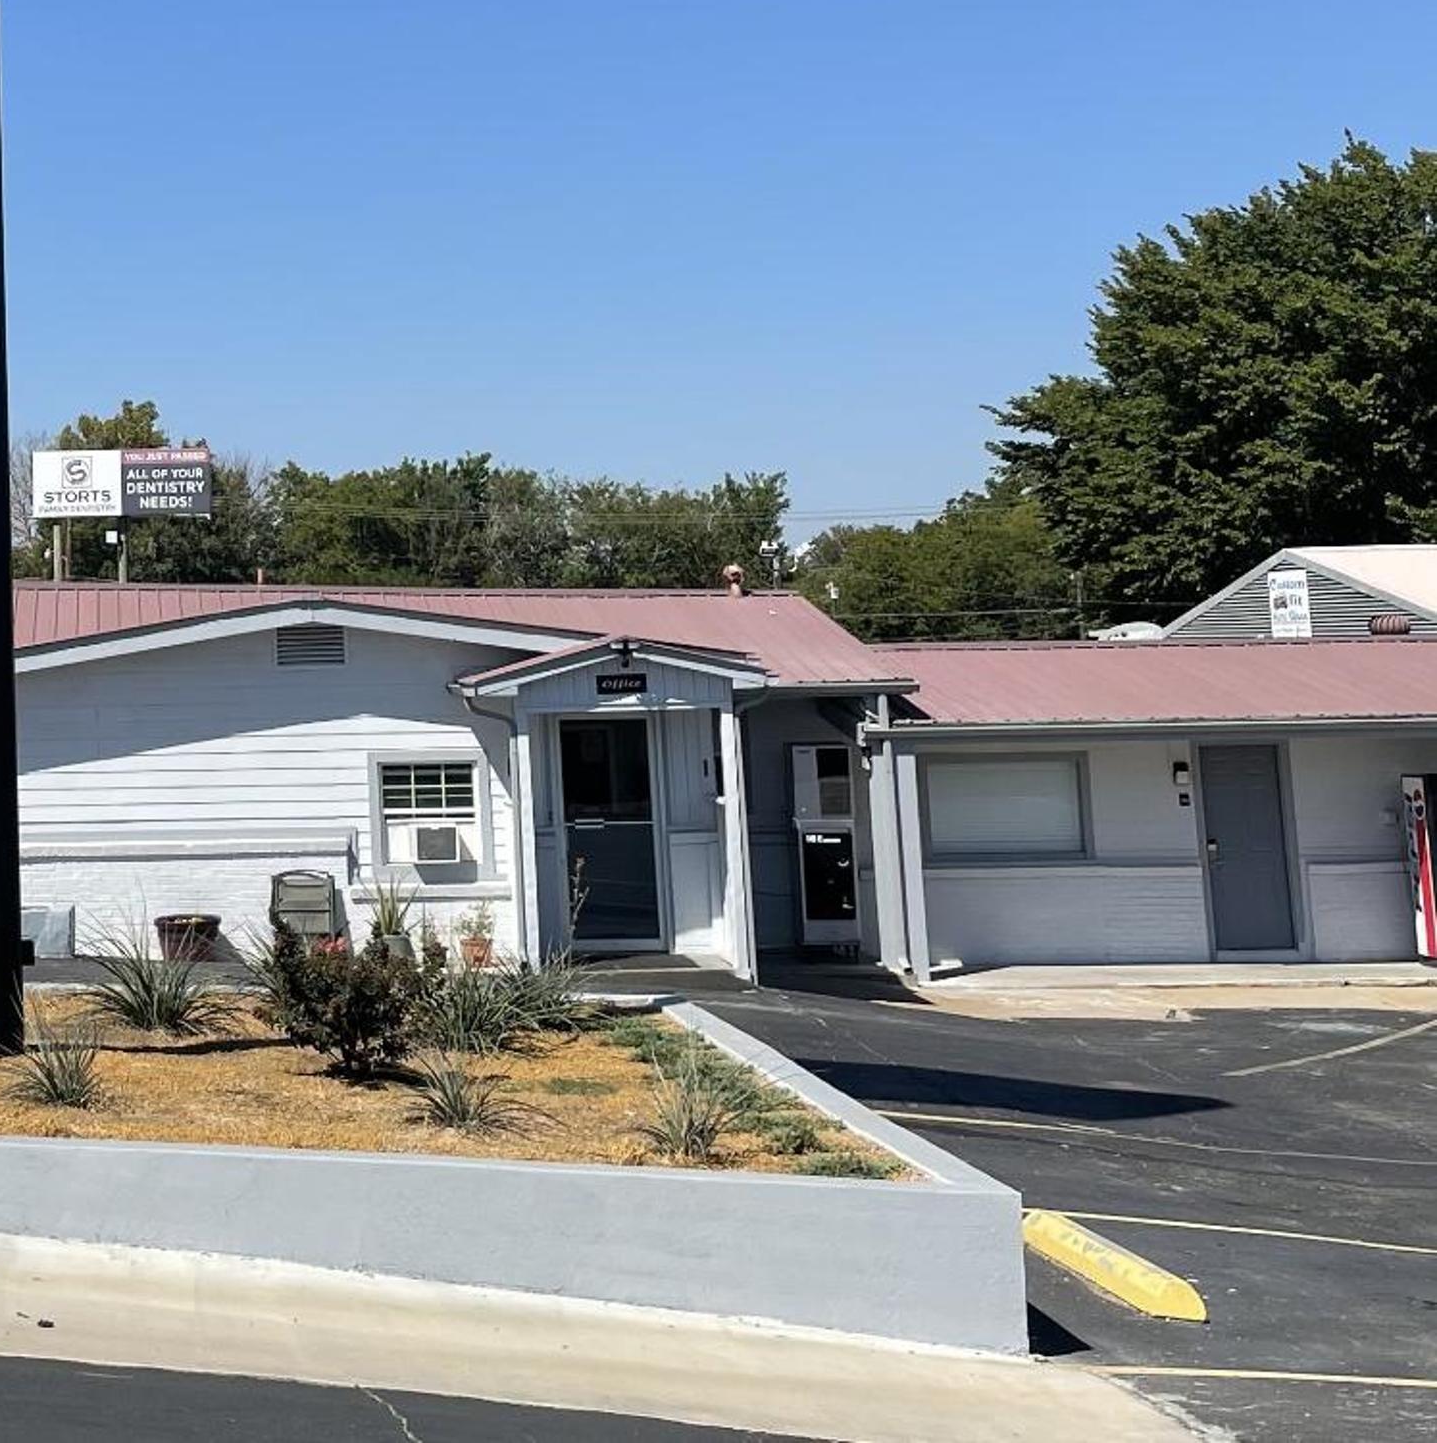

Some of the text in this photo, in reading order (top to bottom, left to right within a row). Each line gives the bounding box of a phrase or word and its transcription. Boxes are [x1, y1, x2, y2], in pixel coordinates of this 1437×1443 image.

[126, 467, 203, 480] ALL OF YOUR
[126, 481, 205, 494] DENTISTRY
[44, 490, 112, 504] STORTS
[139, 496, 193, 509] NEEDS!
[601, 678, 642, 689] Office
